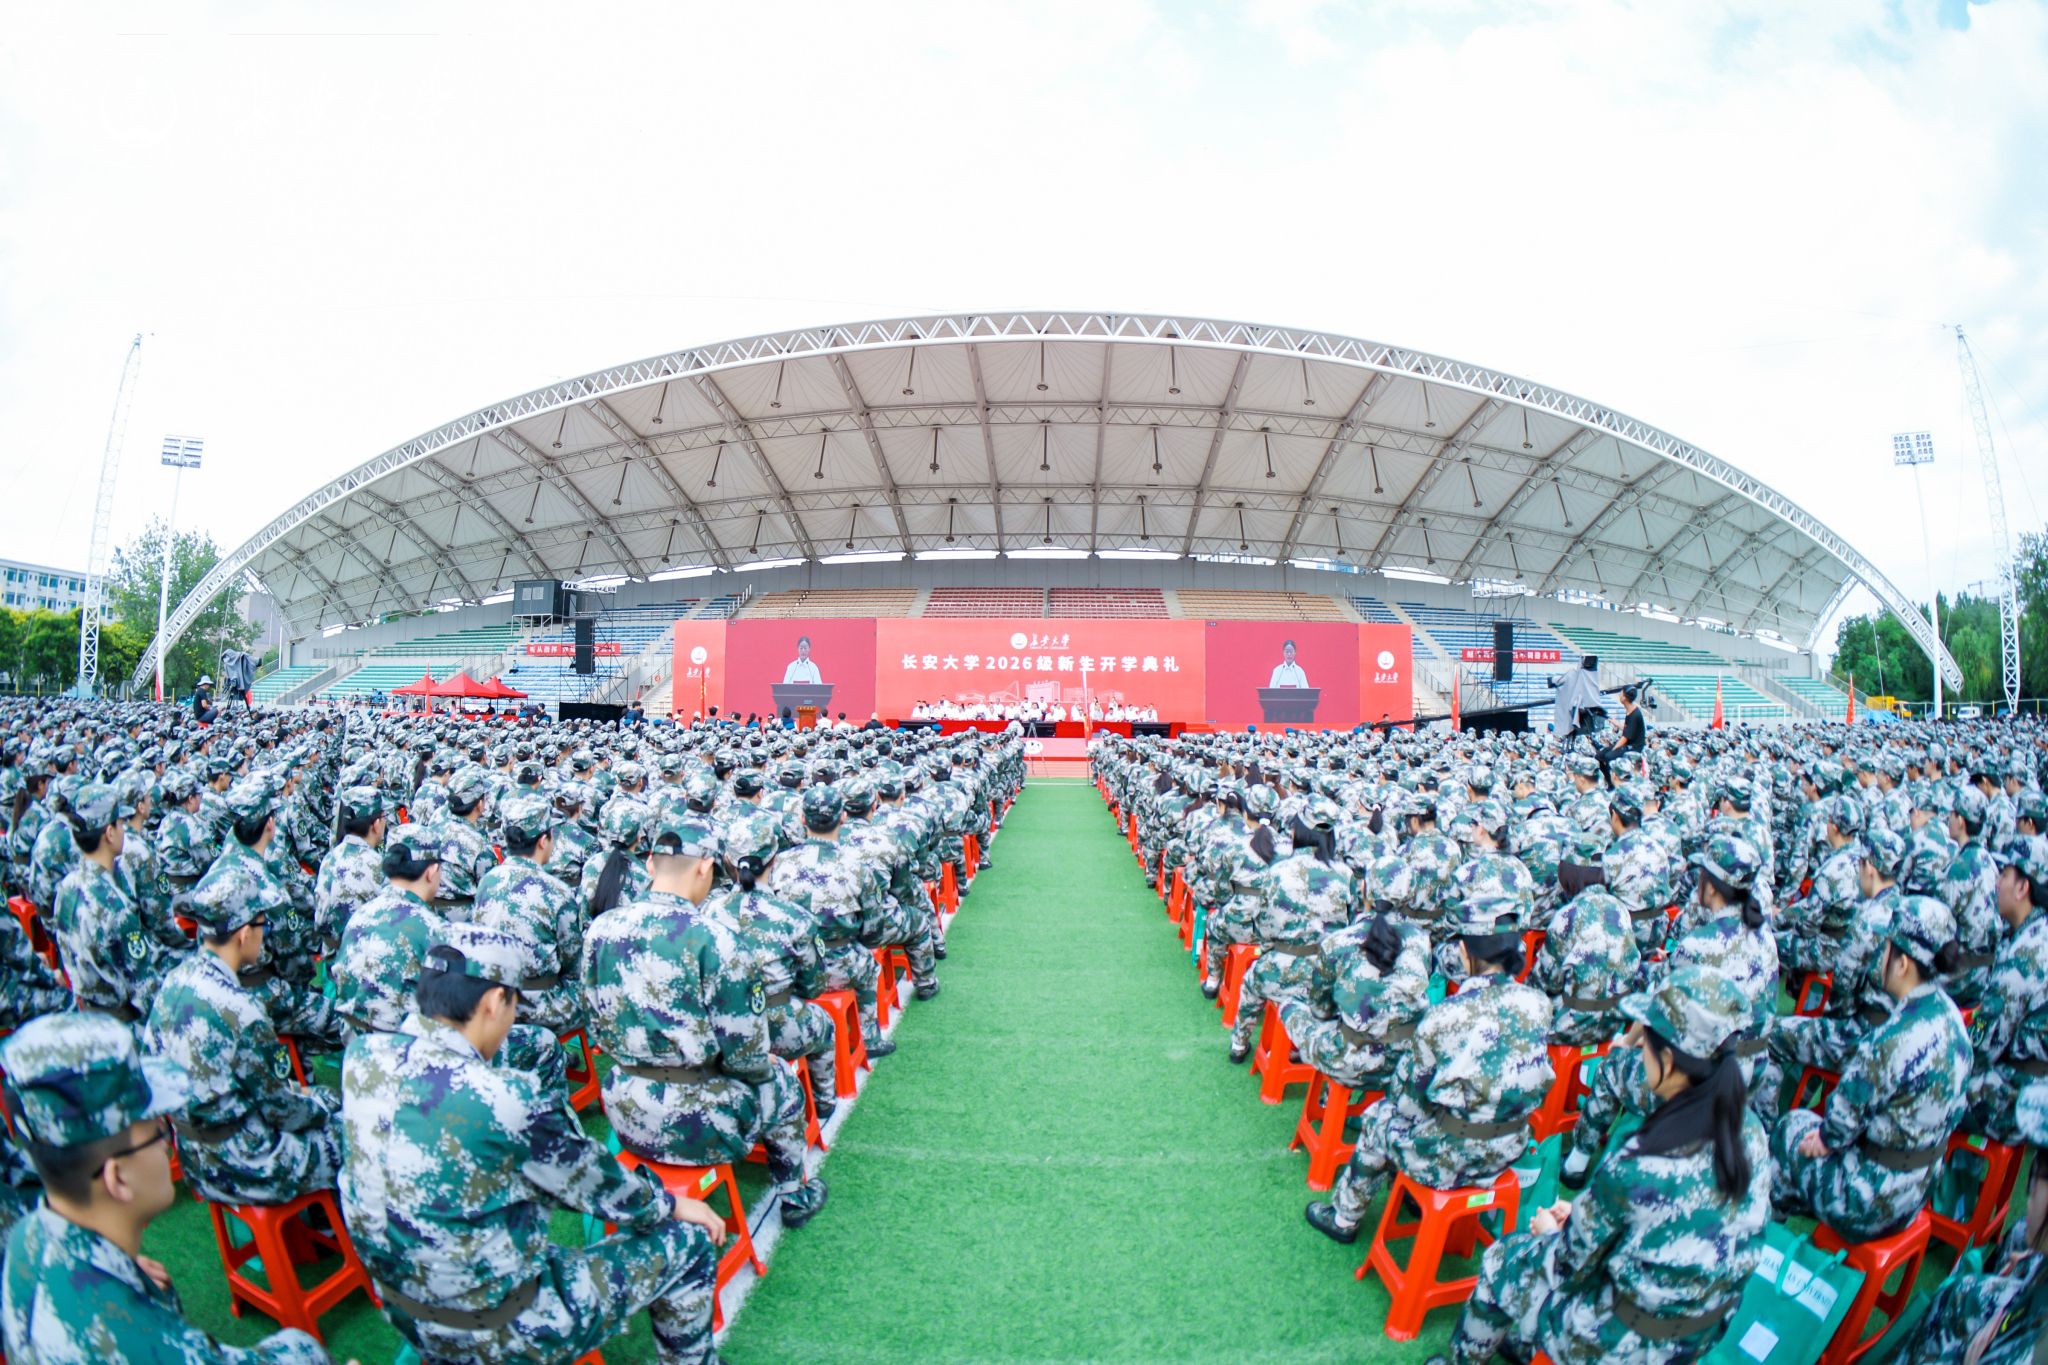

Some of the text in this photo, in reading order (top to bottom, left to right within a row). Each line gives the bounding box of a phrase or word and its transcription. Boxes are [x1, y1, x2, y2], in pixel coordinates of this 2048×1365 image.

[901, 654, 1180, 672] 长安大学2026级新生开学典礼
